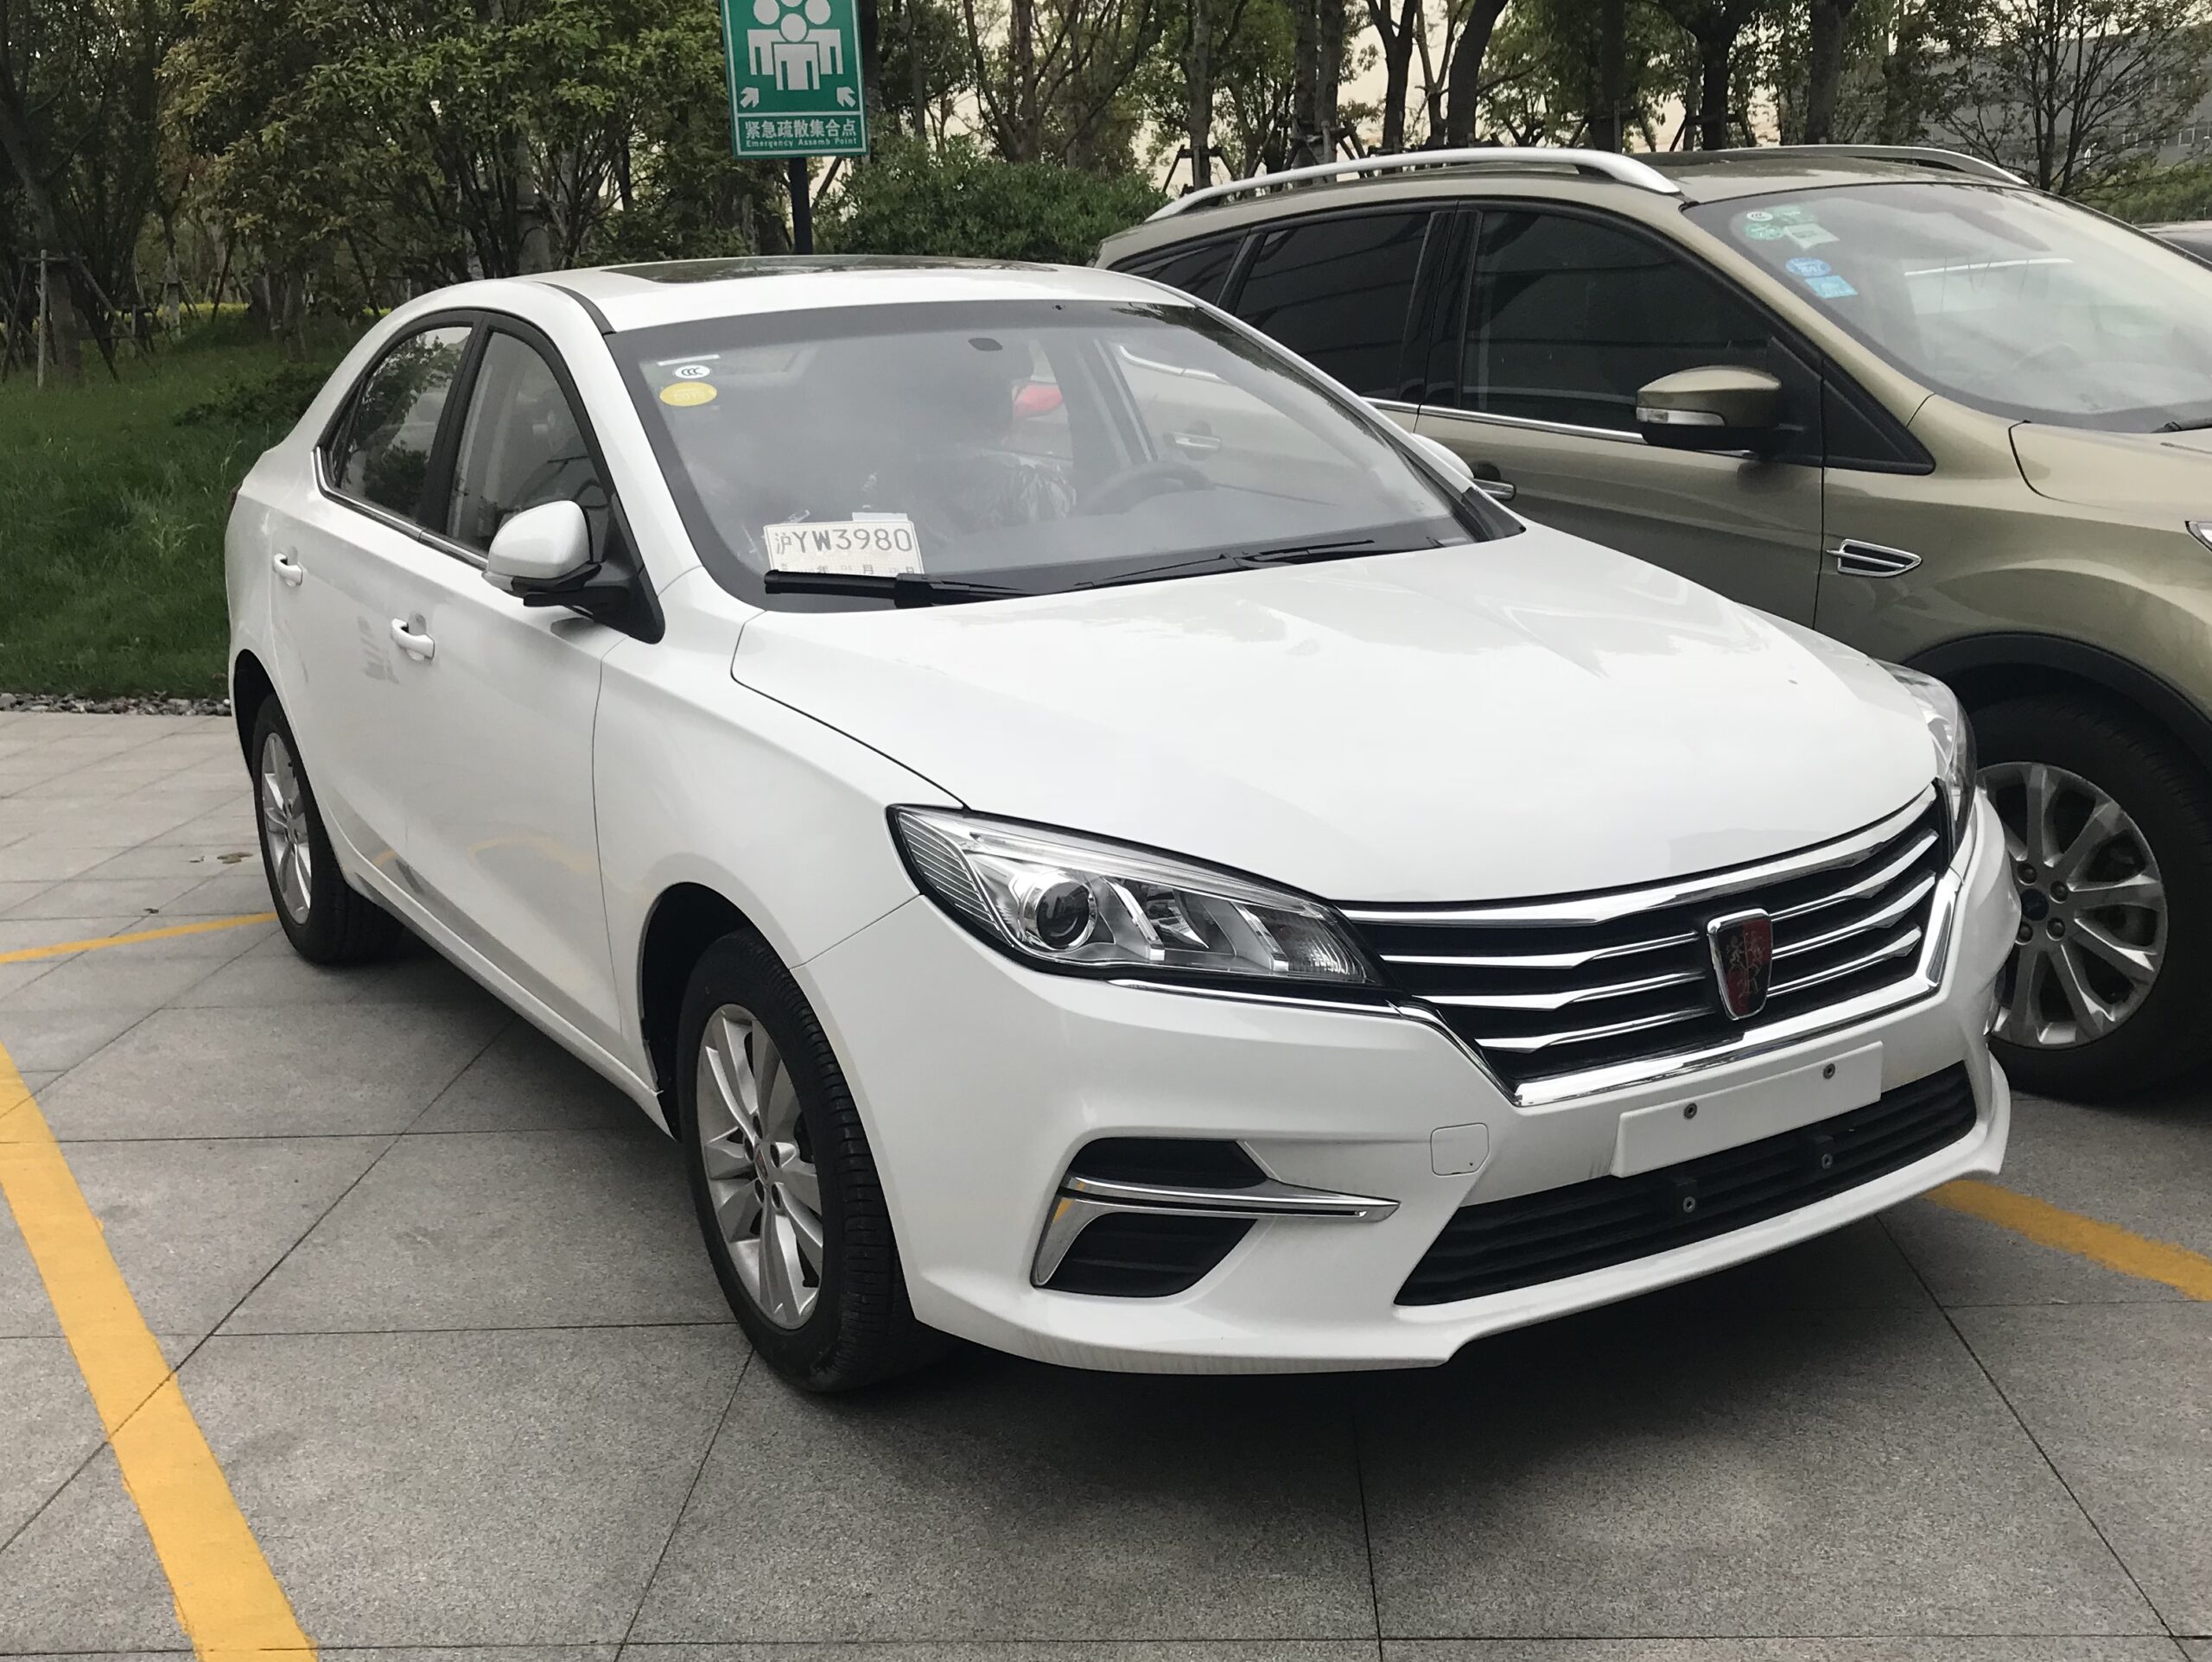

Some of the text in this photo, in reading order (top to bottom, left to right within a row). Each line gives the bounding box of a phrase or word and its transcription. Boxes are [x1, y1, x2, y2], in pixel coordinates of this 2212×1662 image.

[745, 118, 857, 139] 紧急疏散集合点
[746, 139, 794, 148] Emergency
[835, 136, 857, 145] Point
[774, 528, 913, 555] 沪YW3980
